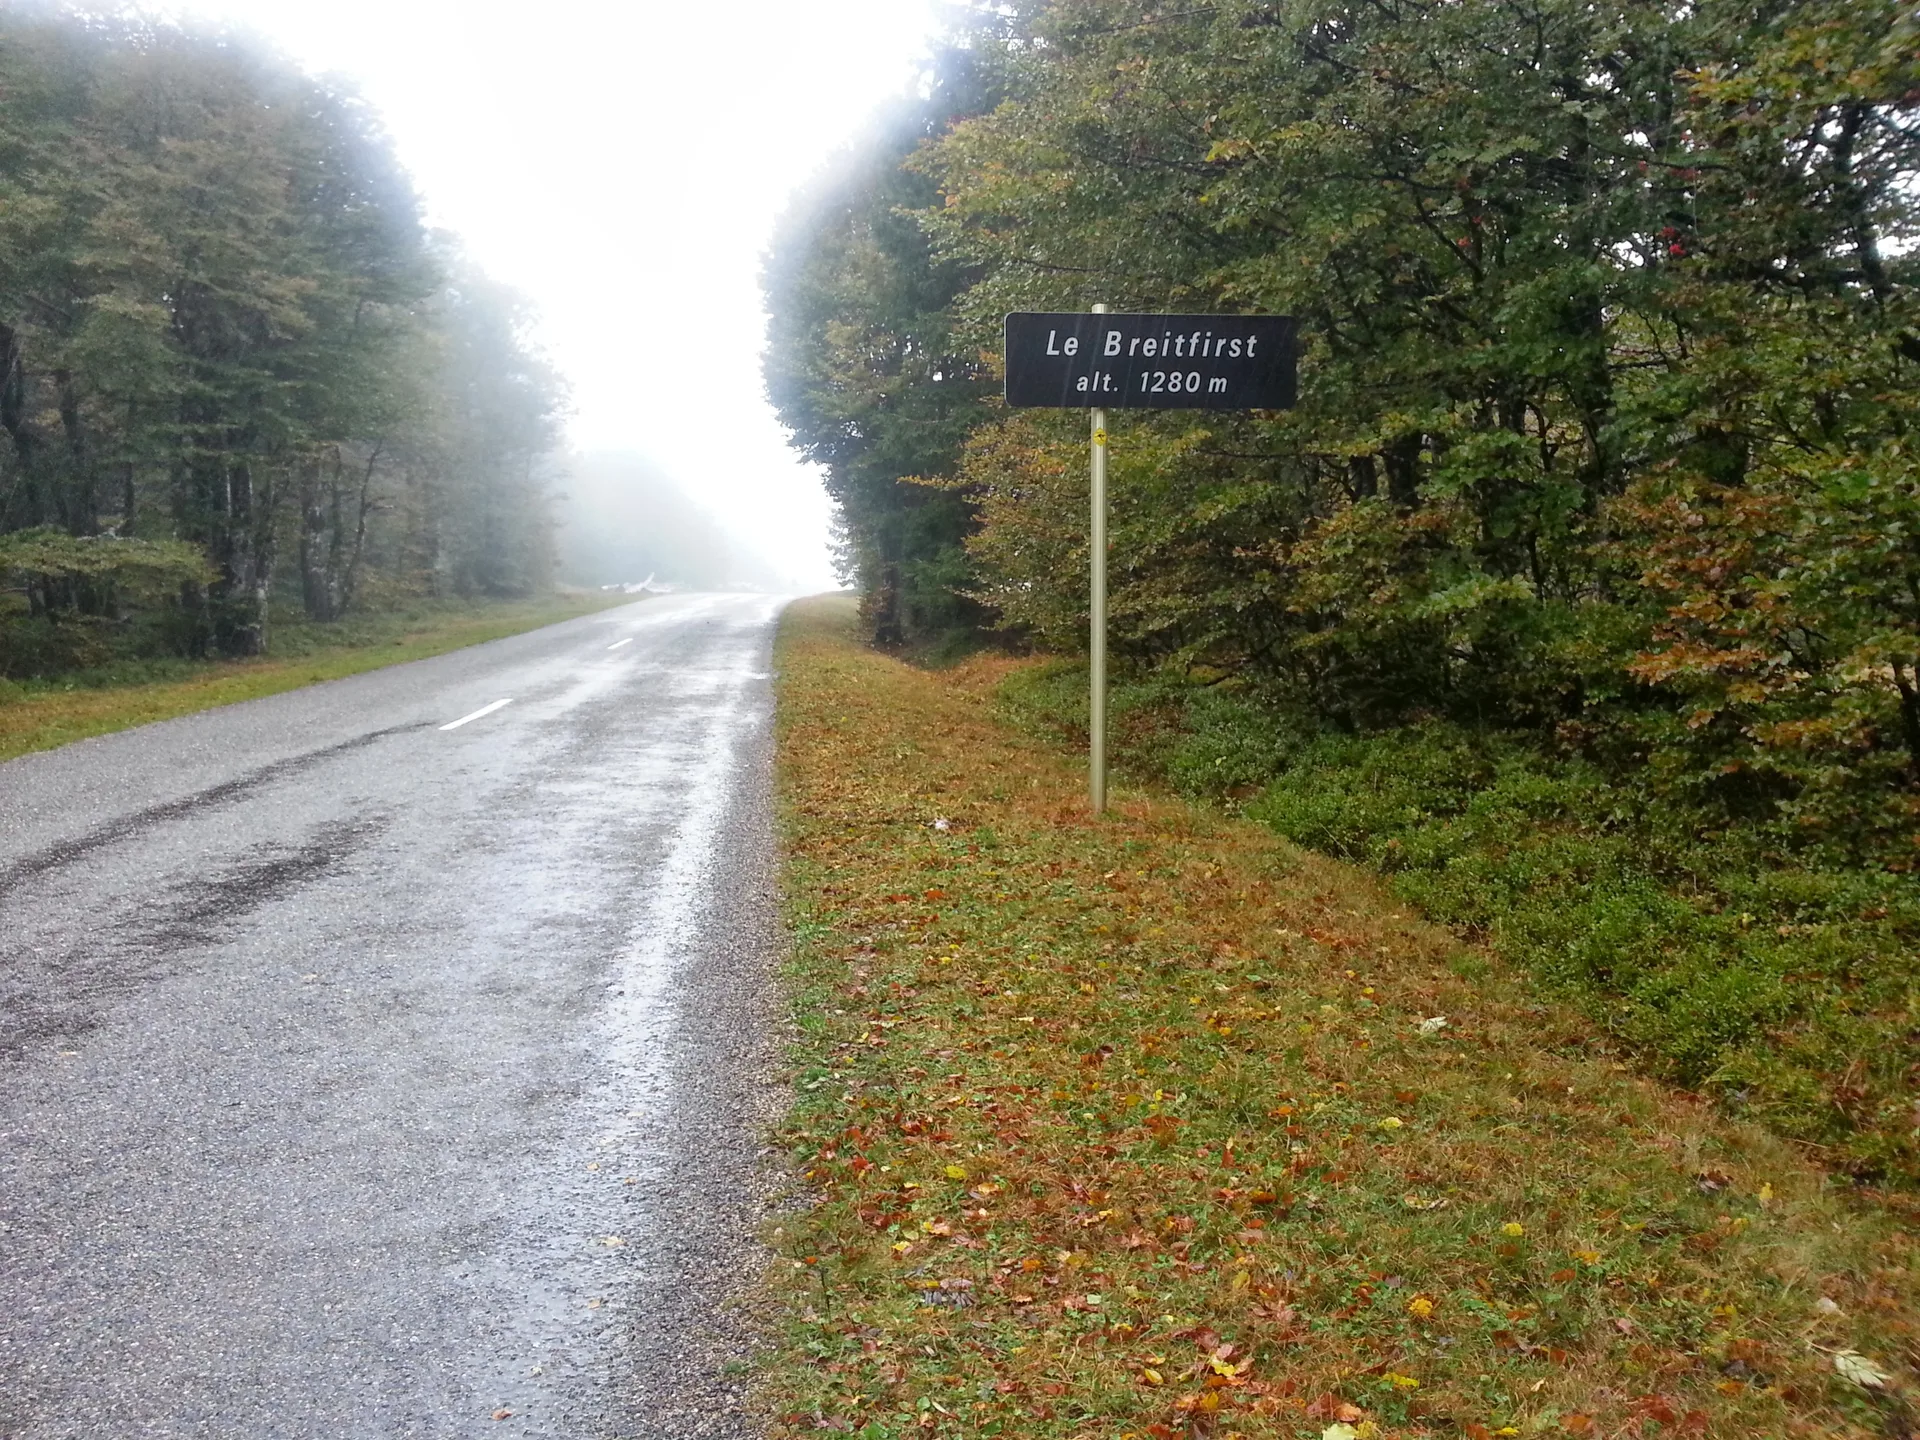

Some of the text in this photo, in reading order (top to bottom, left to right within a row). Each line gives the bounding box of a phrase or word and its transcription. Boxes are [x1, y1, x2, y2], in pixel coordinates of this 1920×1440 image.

[1046, 330, 1258, 358] Le Breitfirst
[1076, 371, 1228, 393] alt. 1280 m
